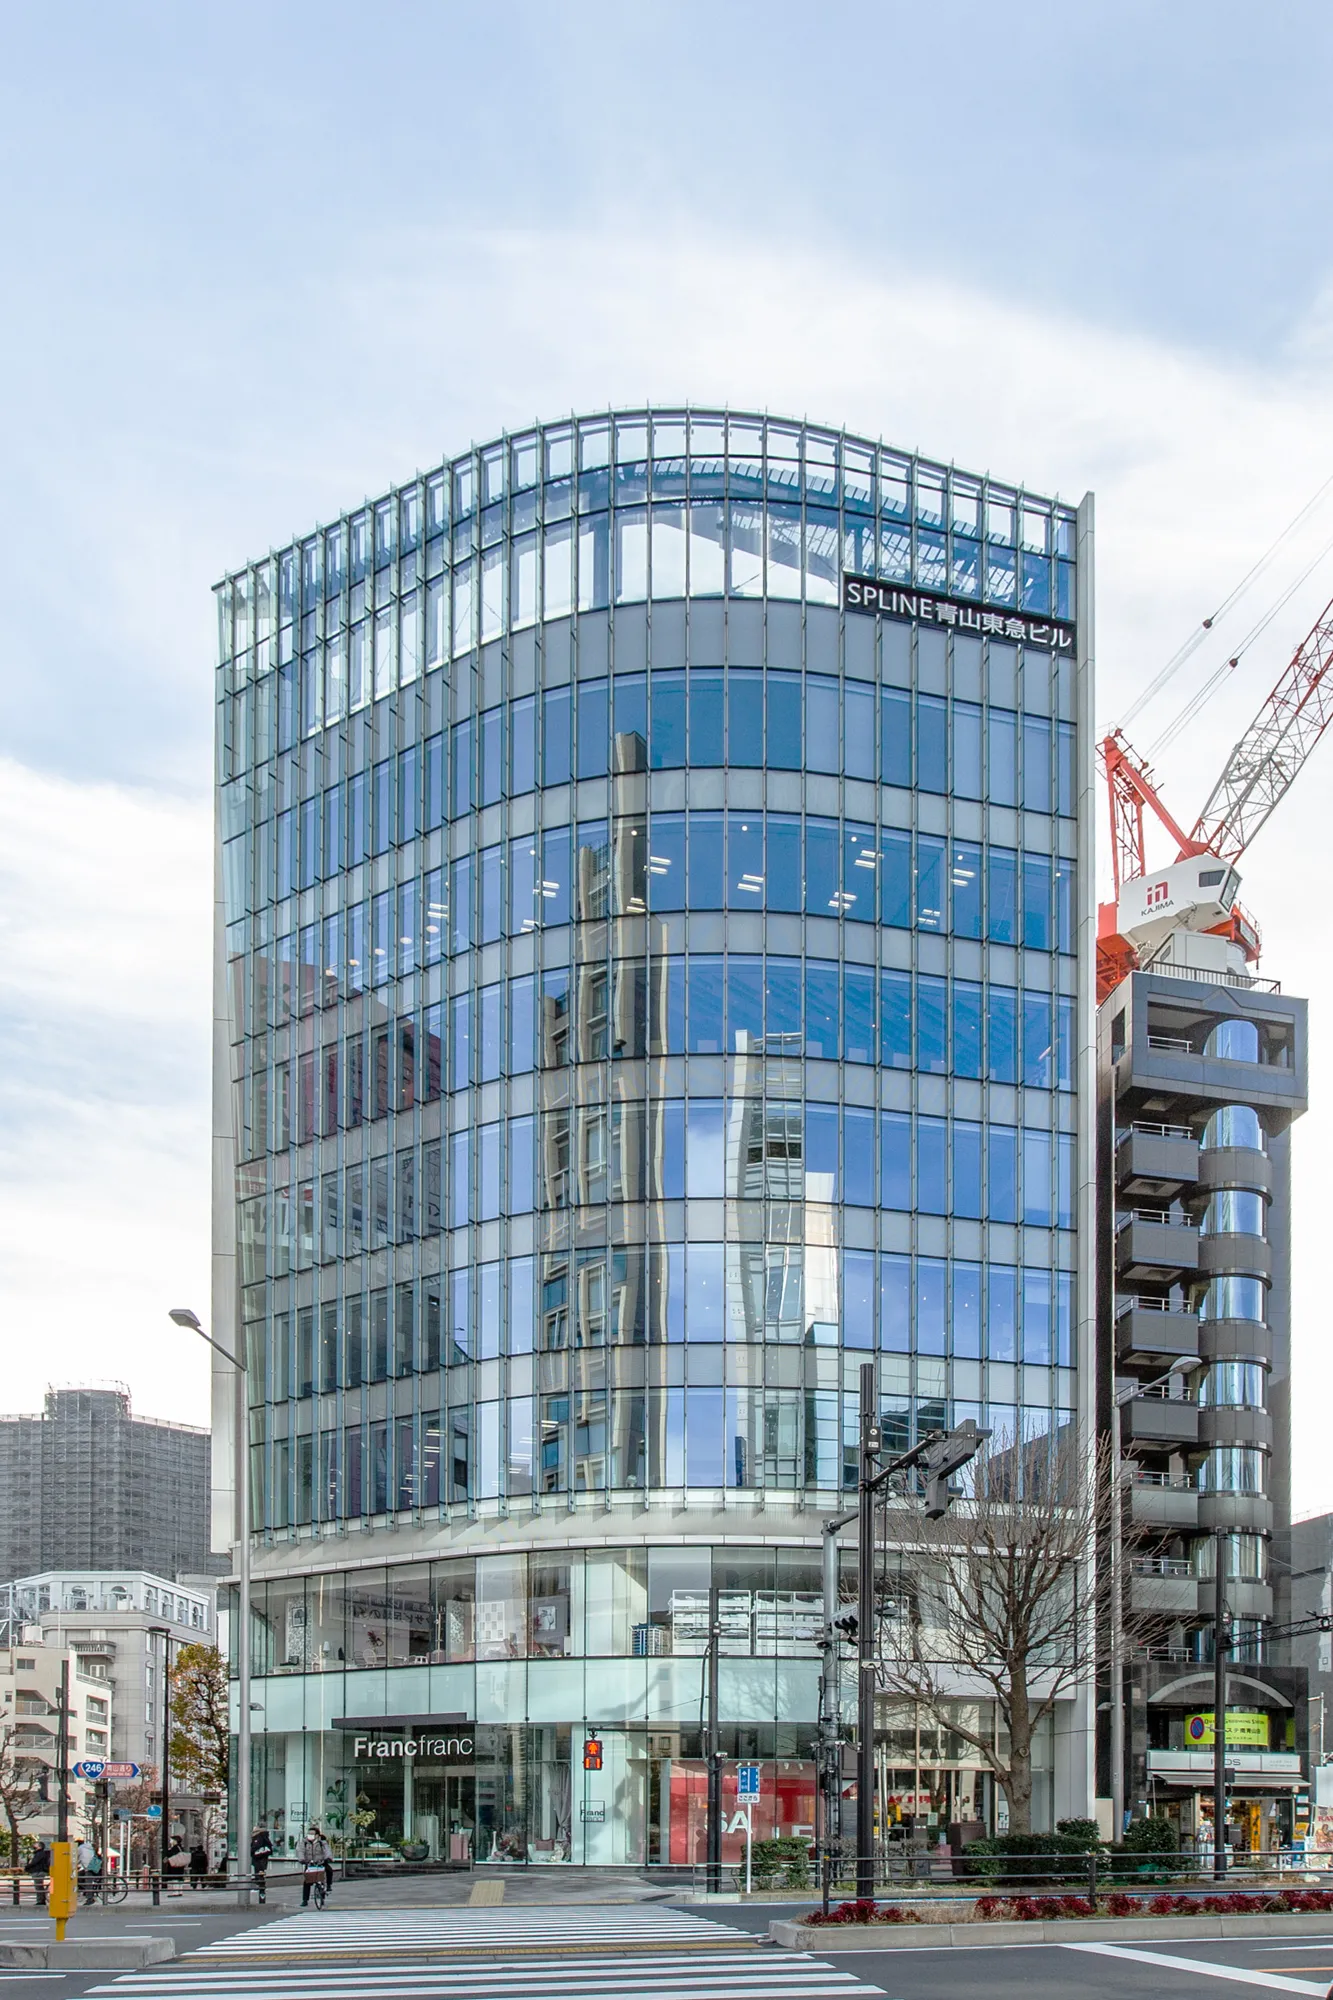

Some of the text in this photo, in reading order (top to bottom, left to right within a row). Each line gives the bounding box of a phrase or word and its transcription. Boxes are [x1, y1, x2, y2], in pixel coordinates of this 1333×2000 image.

[846, 582, 1072, 648] SPLINE青山東急ビル
[1140, 899, 1175, 917] KAJIMA
[354, 1734, 474, 1758] Francfranc
[85, 1763, 102, 1773] 246
